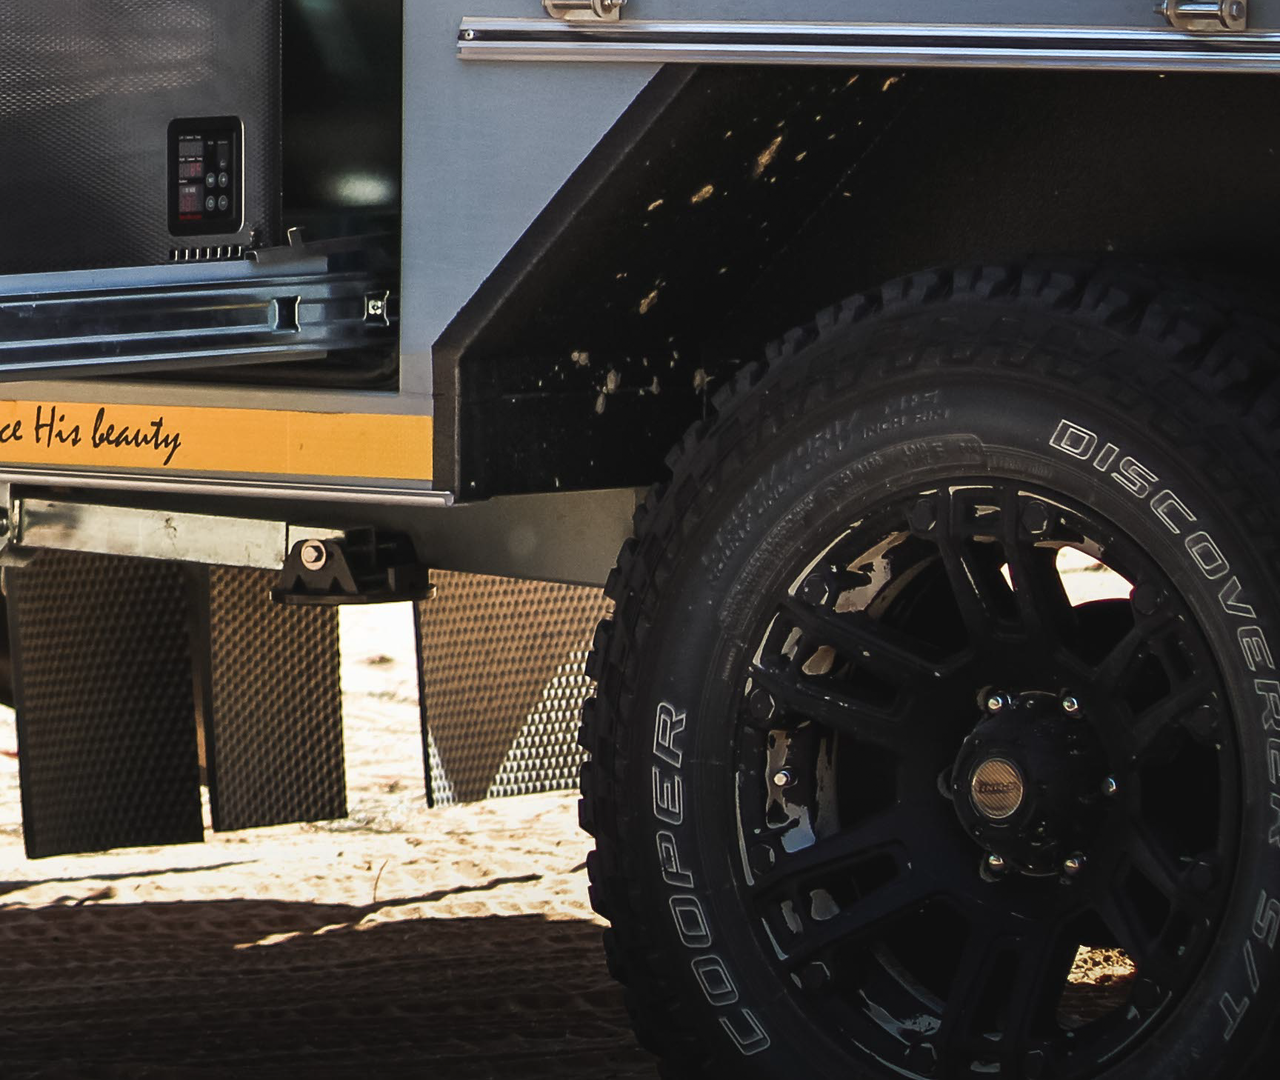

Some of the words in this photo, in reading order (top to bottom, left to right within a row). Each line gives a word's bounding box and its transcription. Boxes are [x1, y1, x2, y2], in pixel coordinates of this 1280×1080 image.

[34, 405, 81, 448] His
[91, 407, 182, 466] beauty
[652, 701, 771, 1056] COOPER
